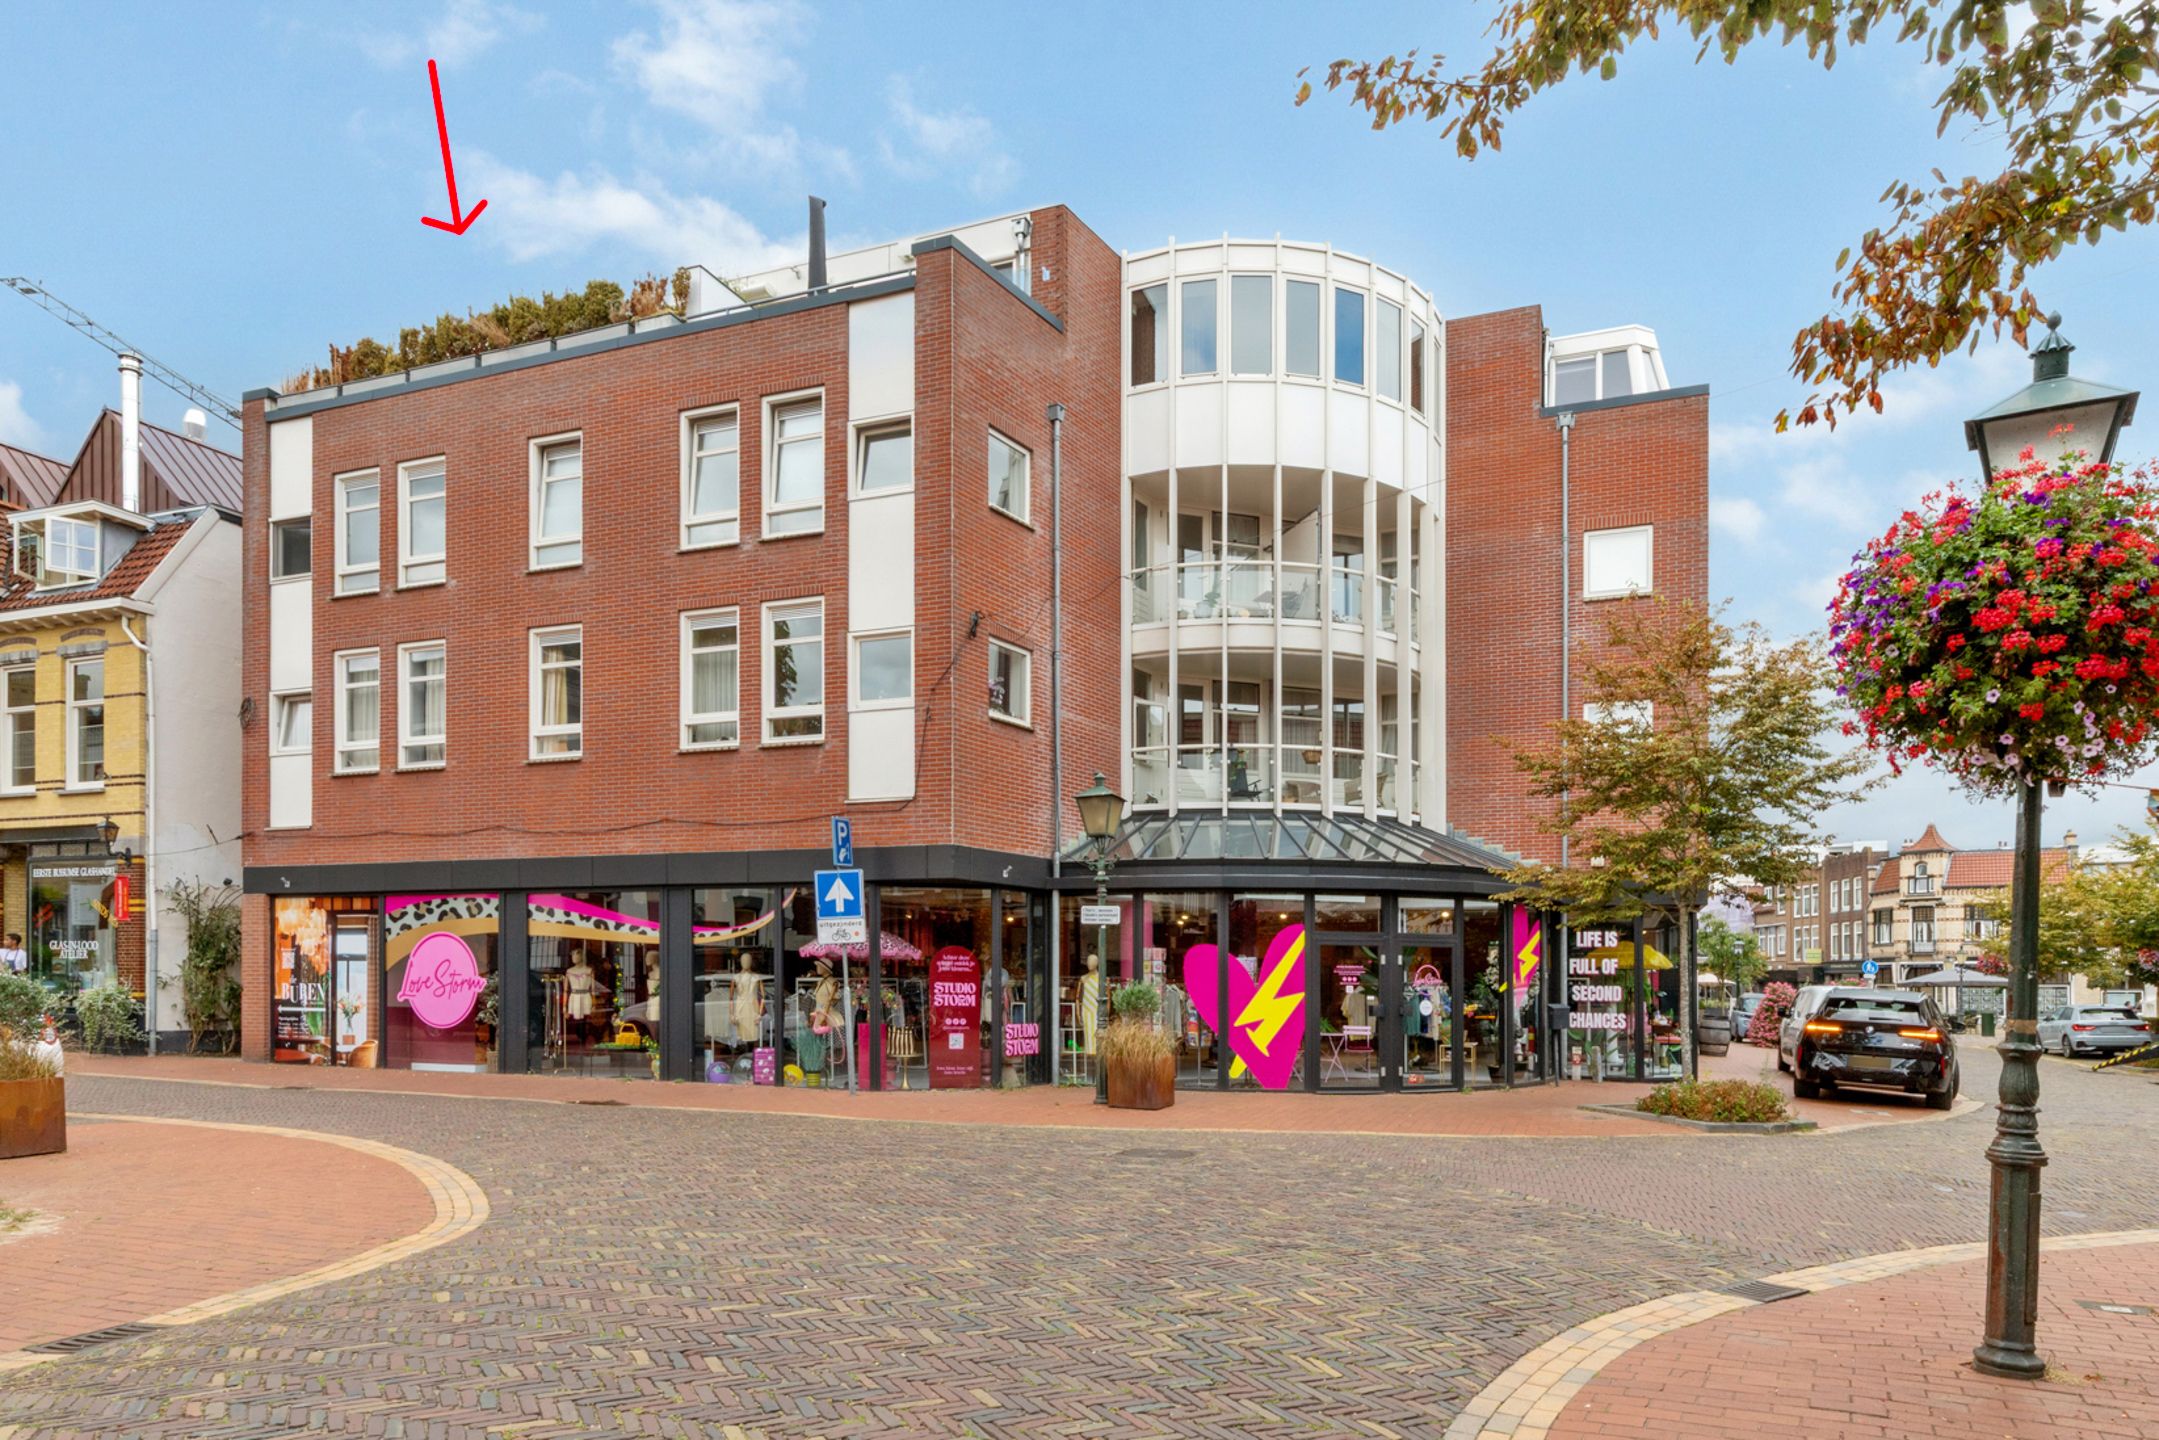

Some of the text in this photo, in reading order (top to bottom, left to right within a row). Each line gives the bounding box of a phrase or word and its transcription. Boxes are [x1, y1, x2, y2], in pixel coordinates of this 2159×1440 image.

[838, 821, 848, 846] P
[819, 920, 863, 929] uitgezonderd
[1576, 931, 1618, 948] LIFE IS
[1569, 958, 1618, 975] FULL OF
[933, 981, 976, 994] STUDIO
[1571, 985, 1622, 1002] SECOND
[933, 994, 976, 1007] STORM
[1569, 1012, 1627, 1029] CHANCES
[1005, 1023, 1039, 1039] STUDIO
[1005, 1039, 1039, 1056] STORM
